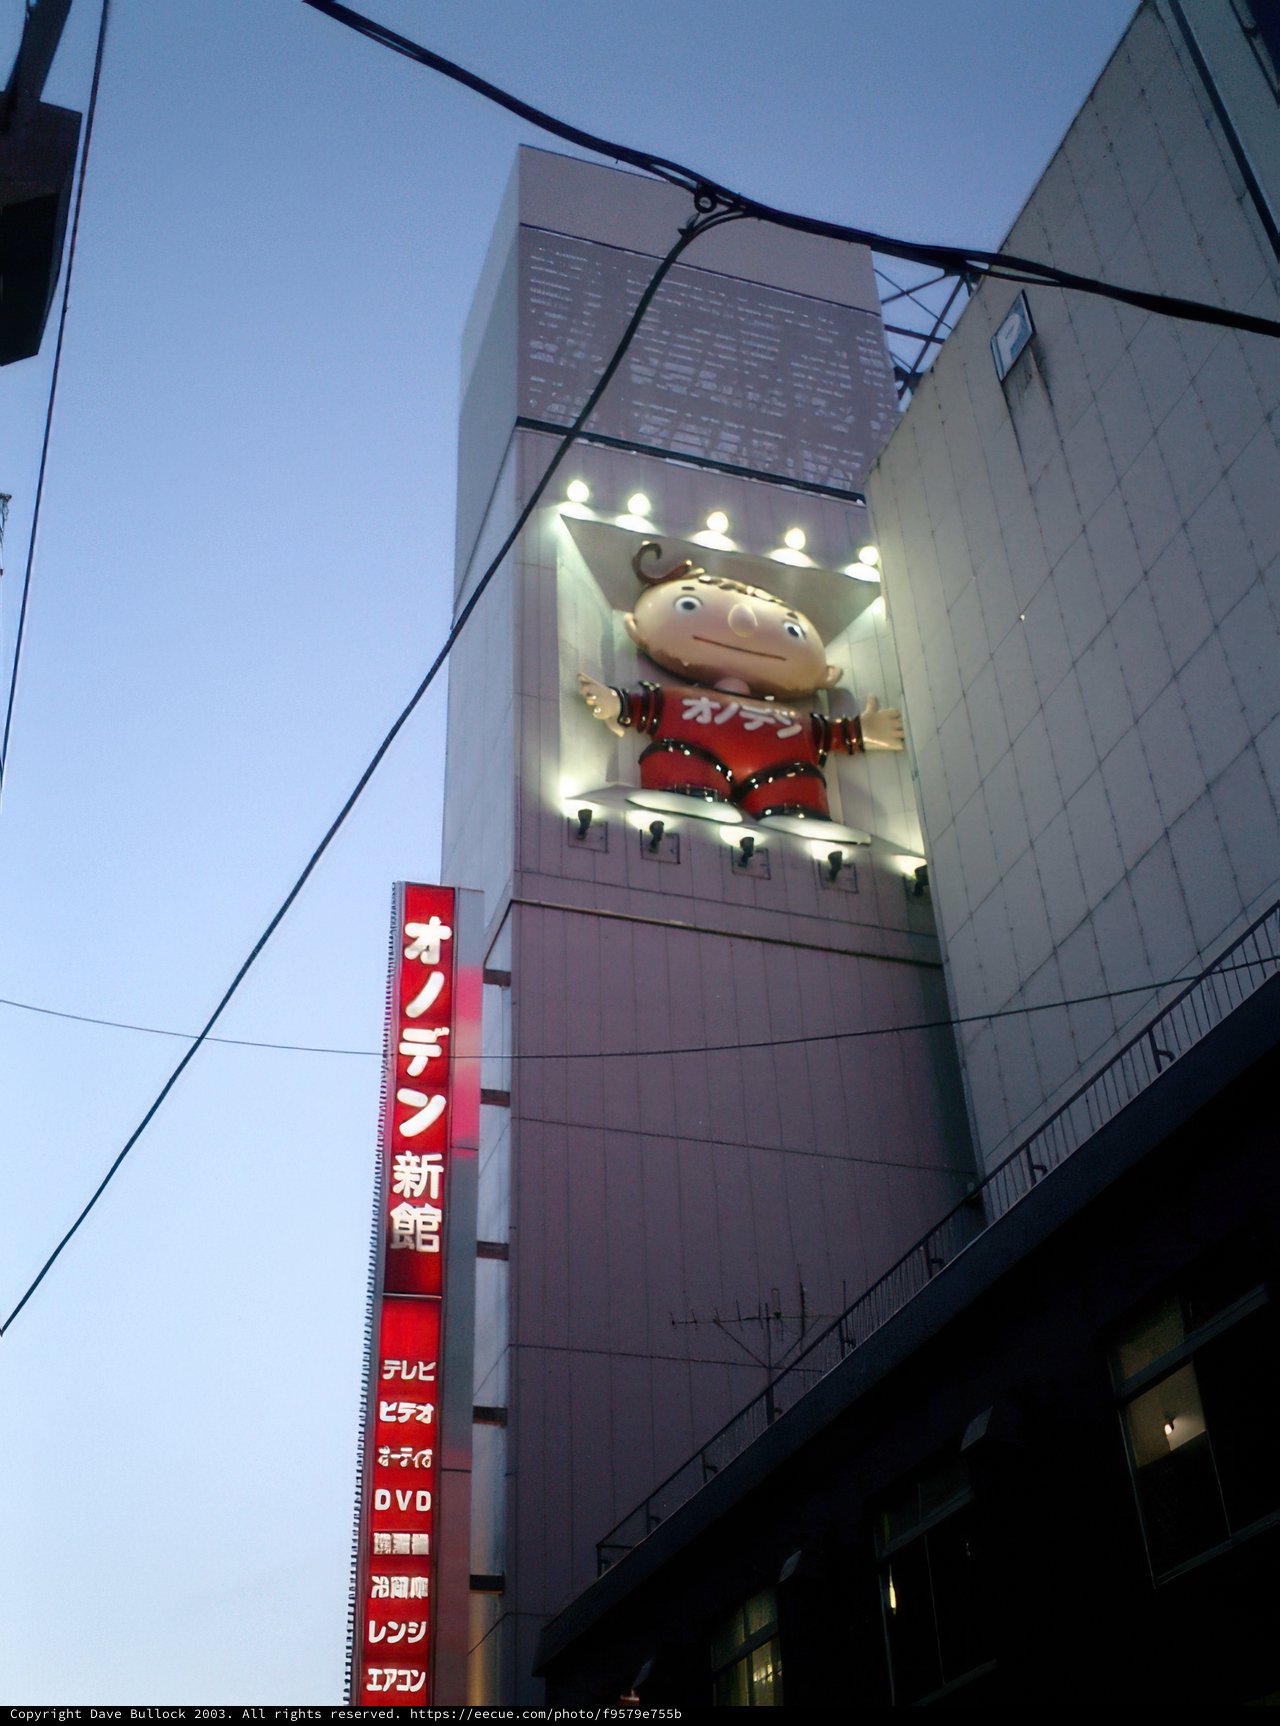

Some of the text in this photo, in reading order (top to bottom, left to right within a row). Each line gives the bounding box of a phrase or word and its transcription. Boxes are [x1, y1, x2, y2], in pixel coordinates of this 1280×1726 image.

[389, 915, 453, 1254] オノデン新館
[374, 1488, 432, 1512] DVD
[368, 1620, 427, 1644] レンジ
[366, 1667, 426, 1693] エアコン
